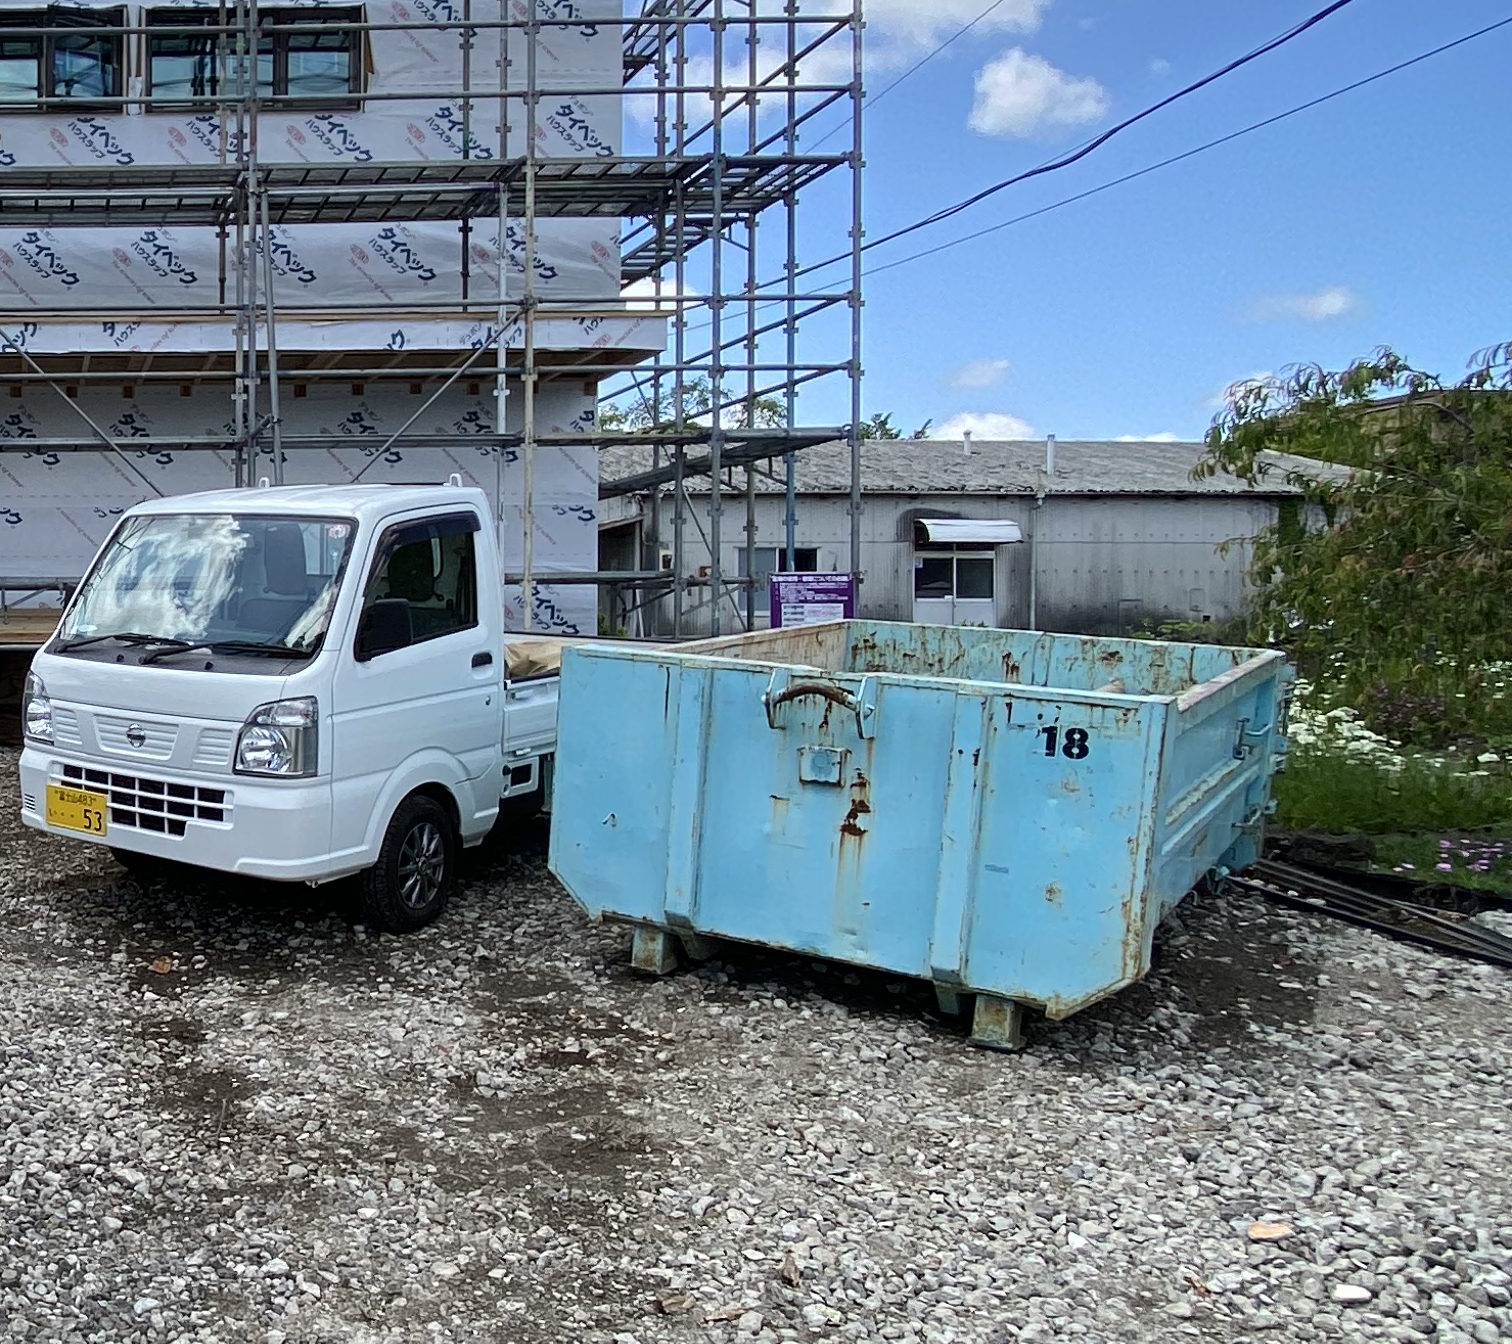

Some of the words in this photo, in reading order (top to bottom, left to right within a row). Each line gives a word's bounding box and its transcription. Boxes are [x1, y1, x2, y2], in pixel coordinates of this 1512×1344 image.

[67, 121, 106, 159] ハウスラップ
[304, 118, 345, 157] ハウスラップ
[545, 114, 585, 153] ハウスラップ
[555, 104, 615, 158] タイベック
[12, 241, 52, 280] ハウスラップ
[21, 231, 81, 287] タイベック
[130, 240, 170, 279] ハウスラップ
[139, 230, 199, 285] タイベック
[367, 237, 408, 275] ハウスラップ
[377, 227, 437, 281] タイベック
[1040, 723, 1090, 760] 18
[83, 808, 102, 832] 53
